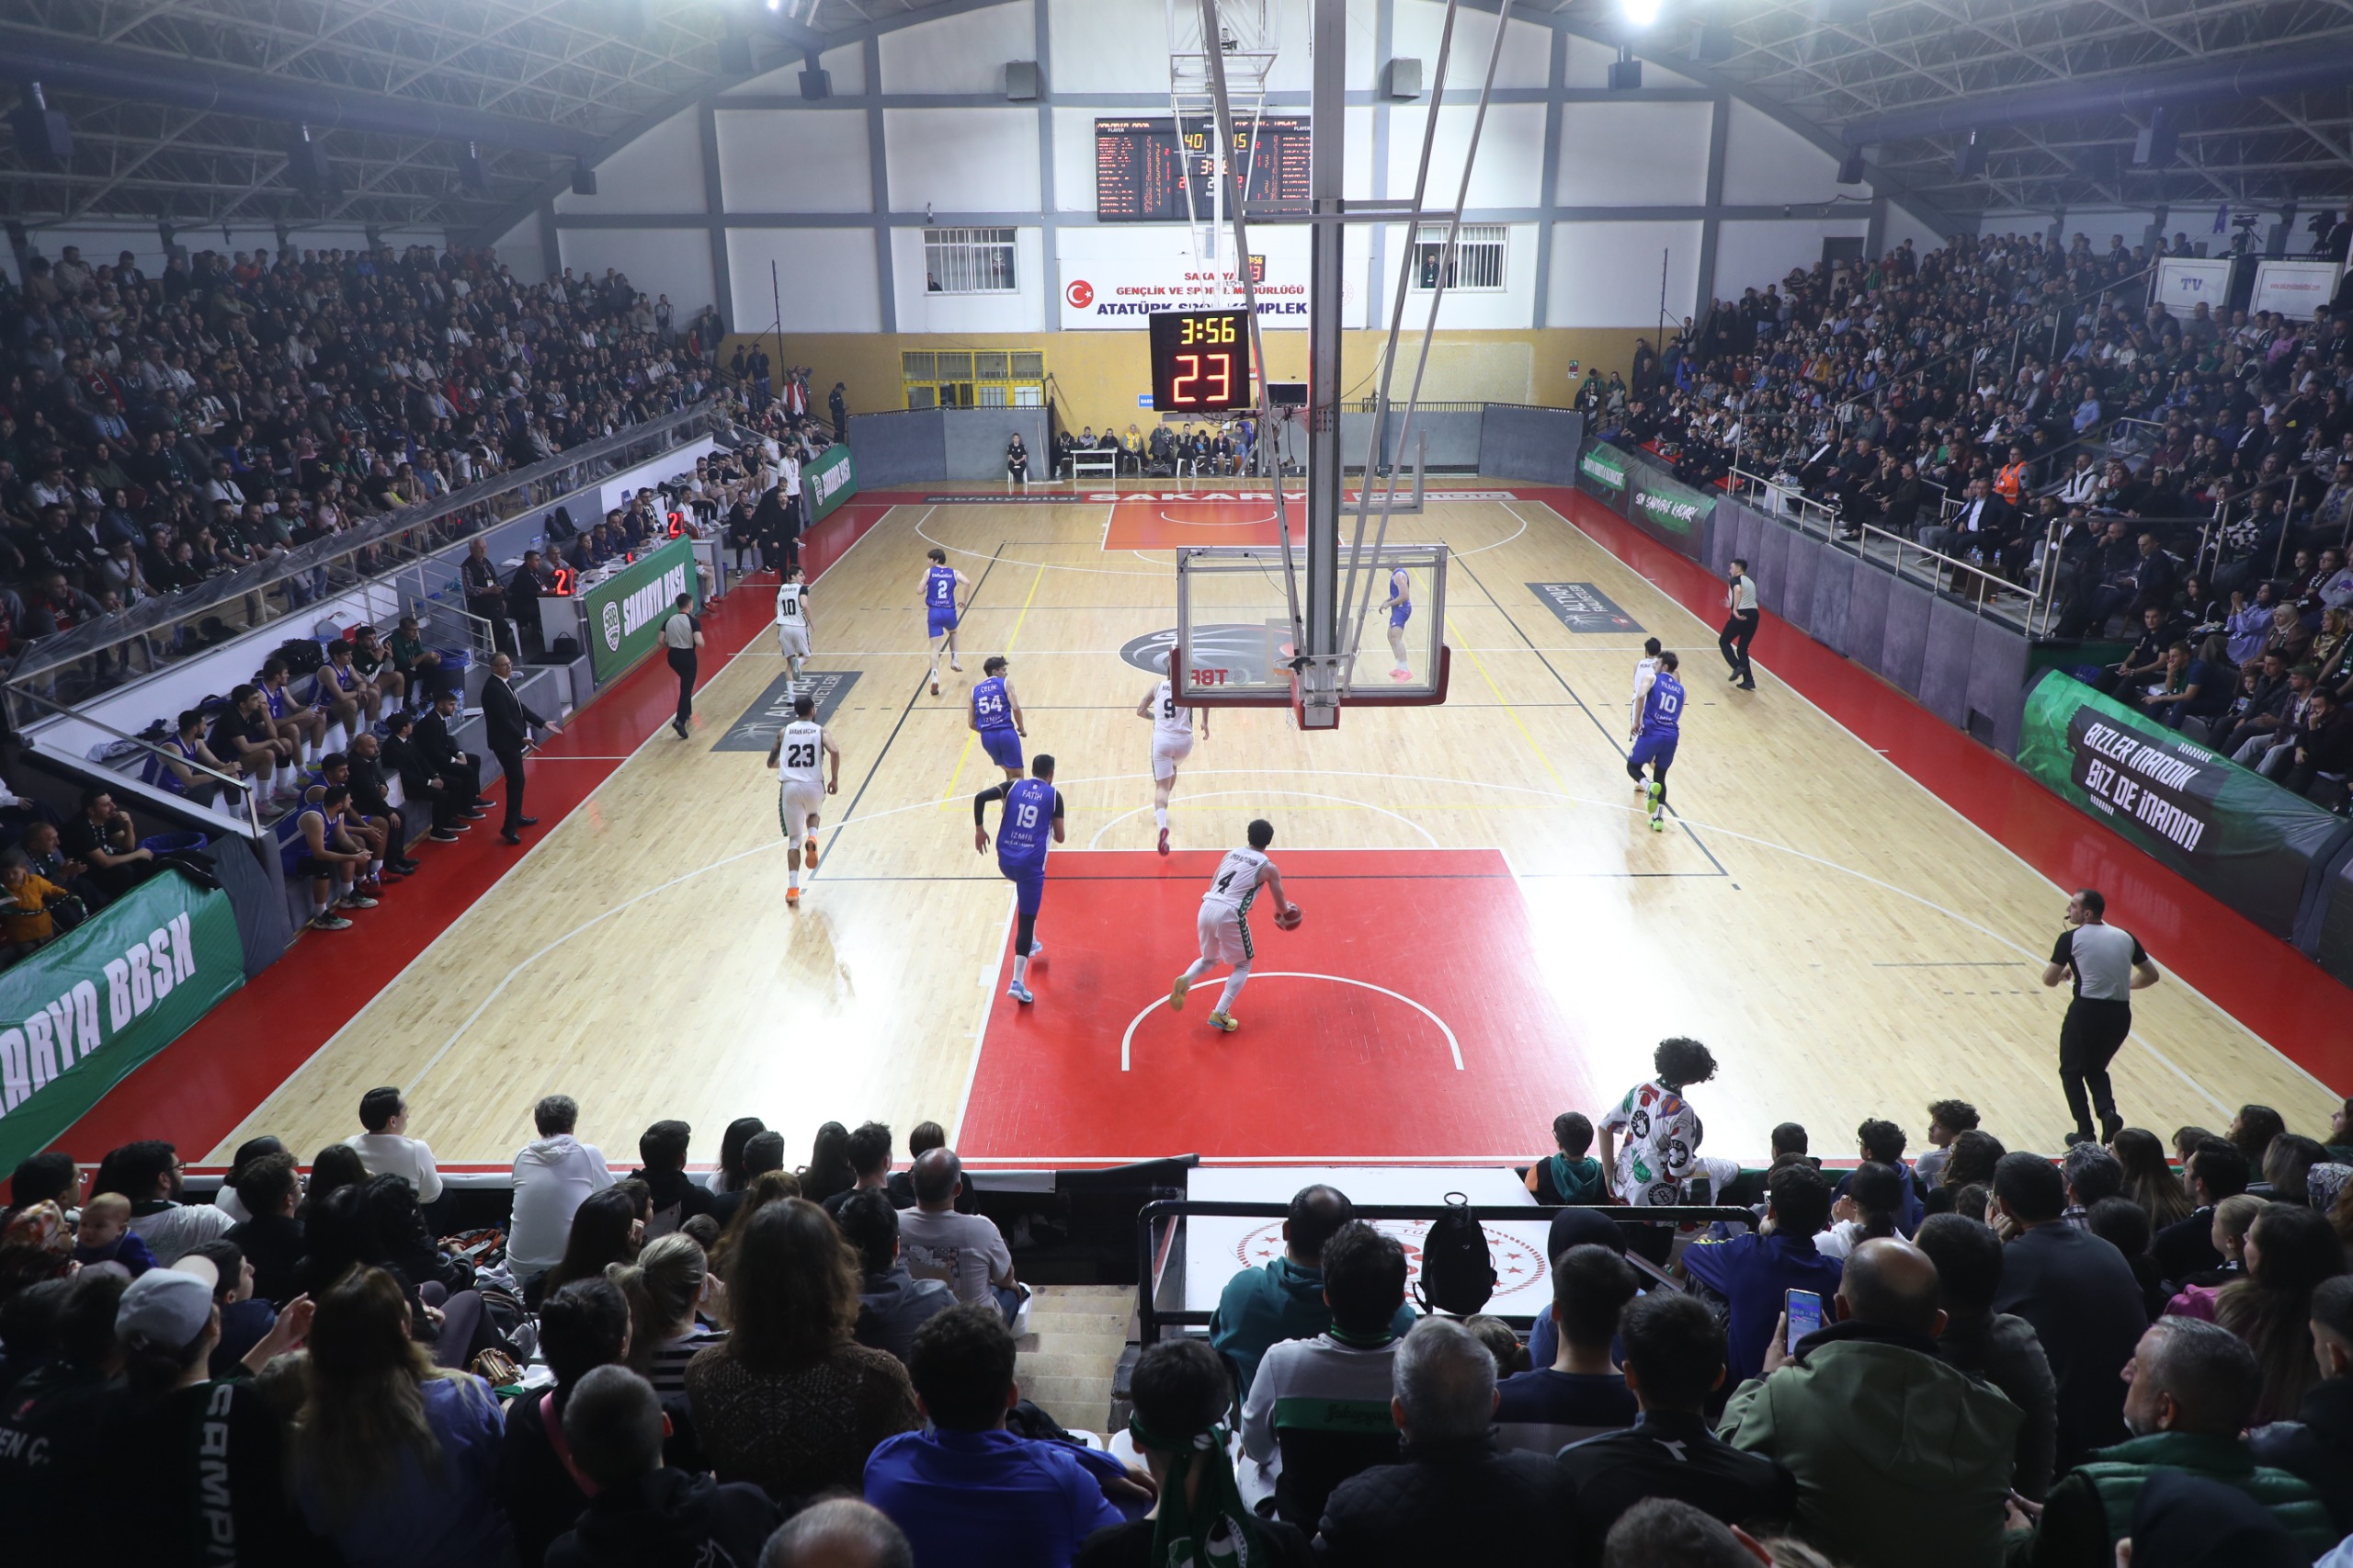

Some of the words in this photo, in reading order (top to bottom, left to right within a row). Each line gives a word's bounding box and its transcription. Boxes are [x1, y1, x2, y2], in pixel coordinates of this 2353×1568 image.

[1184, 133, 1203, 149] 40
[1116, 285, 1165, 297] GENÇLİK
[1168, 287, 1183, 295] VE
[2180, 278, 2203, 291] TV
[1180, 317, 1235, 345] 3:56
[1174, 354, 1229, 403] 23
[938, 580, 948, 599] 2
[623, 577, 664, 637] SAKARYA
[781, 598, 797, 617] 10
[981, 684, 997, 694] ÇELİK
[978, 695, 1003, 715] 54
[1164, 698, 1176, 719] 9
[1658, 691, 1677, 714] 10
[788, 744, 815, 768] 23
[1021, 790, 1042, 801] FATİH
[2112, 775, 2140, 812] DE
[1016, 803, 1039, 829] 19
[1218, 870, 1237, 894] 4
[0, 979, 102, 1119] ARYA
[103, 911, 196, 1034] BBSK
